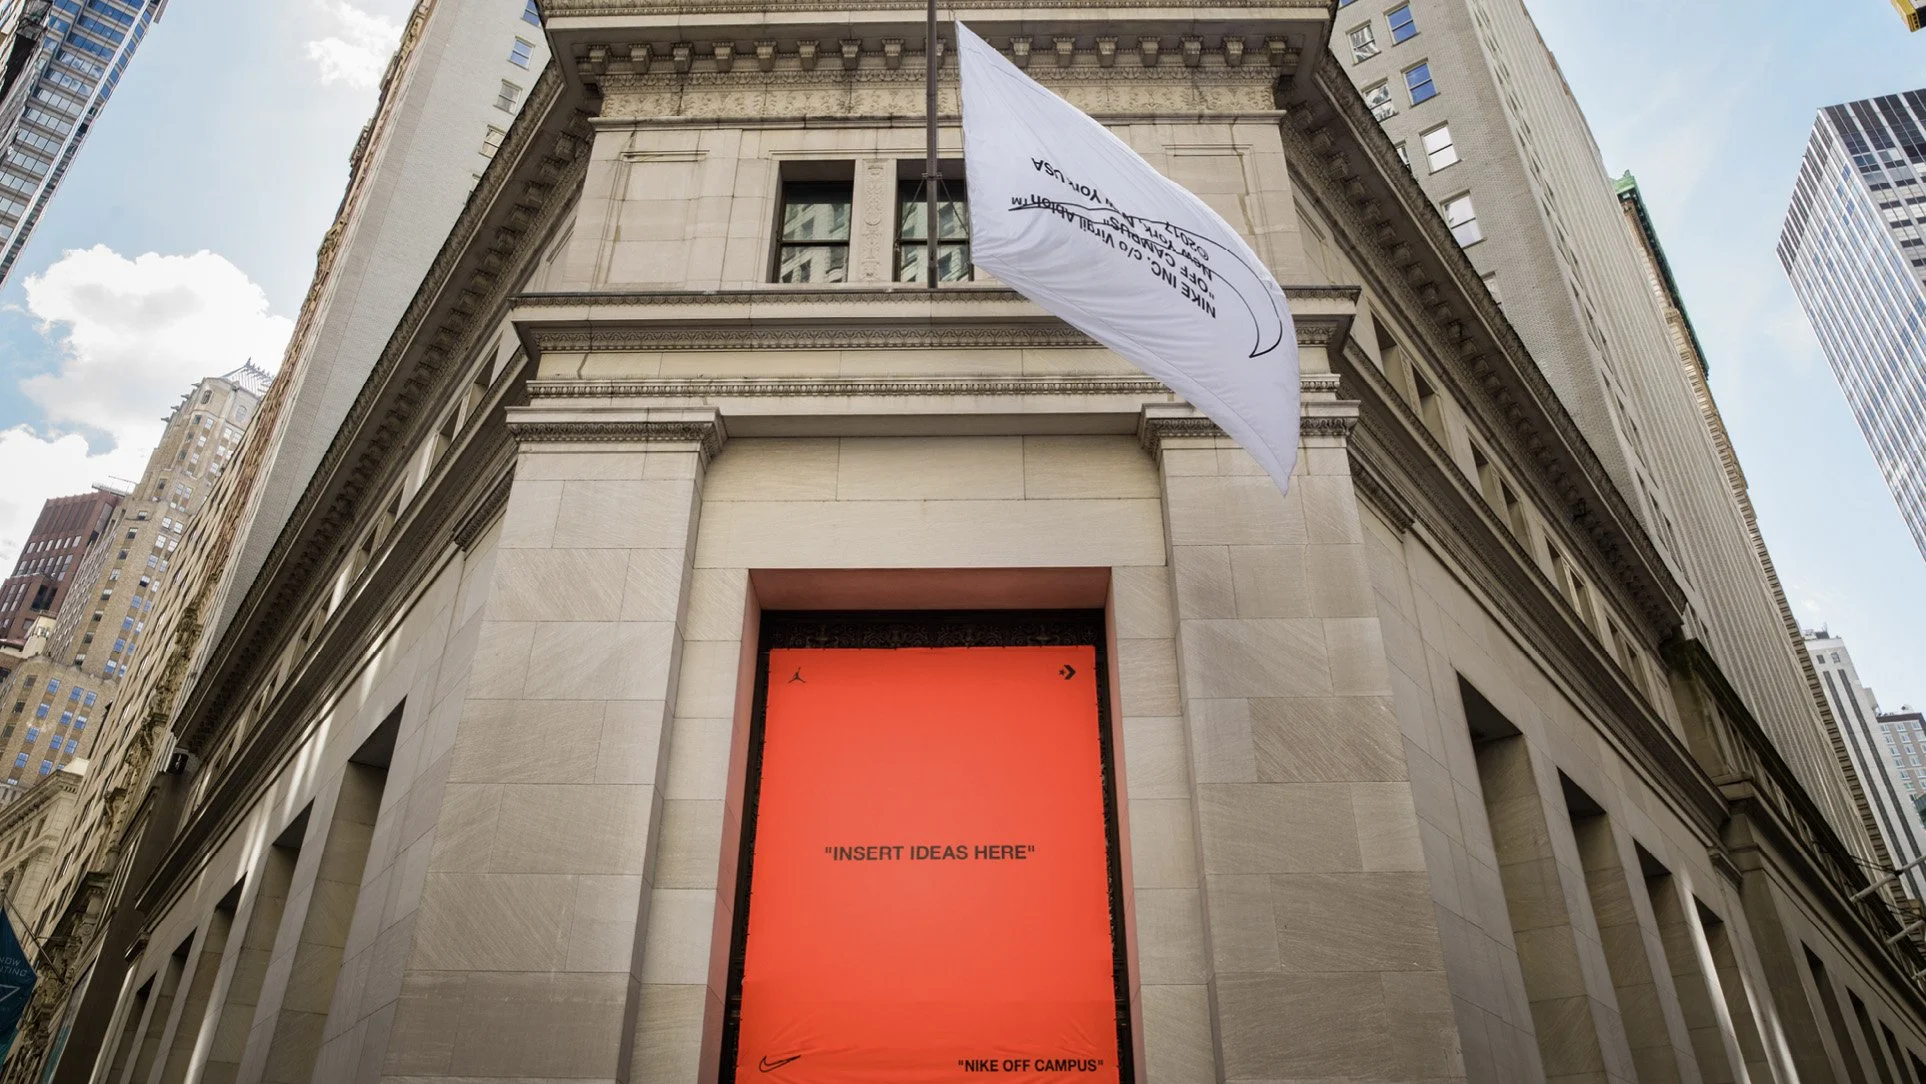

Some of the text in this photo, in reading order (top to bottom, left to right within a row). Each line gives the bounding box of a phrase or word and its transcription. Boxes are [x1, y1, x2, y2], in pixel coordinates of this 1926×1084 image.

[1031, 157, 1065, 183] USA
[1079, 216, 1115, 248] Virgil
[1165, 221, 1209, 261] ©2017
[1103, 216, 1215, 300] "OFF CAMPUS"
[1119, 241, 1143, 260] c/o
[1181, 249, 1213, 281] New
[1147, 257, 1177, 288] INC.
[1181, 281, 1216, 319] NIKE
[825, 845, 1035, 861] "INSERT IDEAS HERE"
[958, 1059, 1104, 1072] "NIKE OFF CAMPUS"
